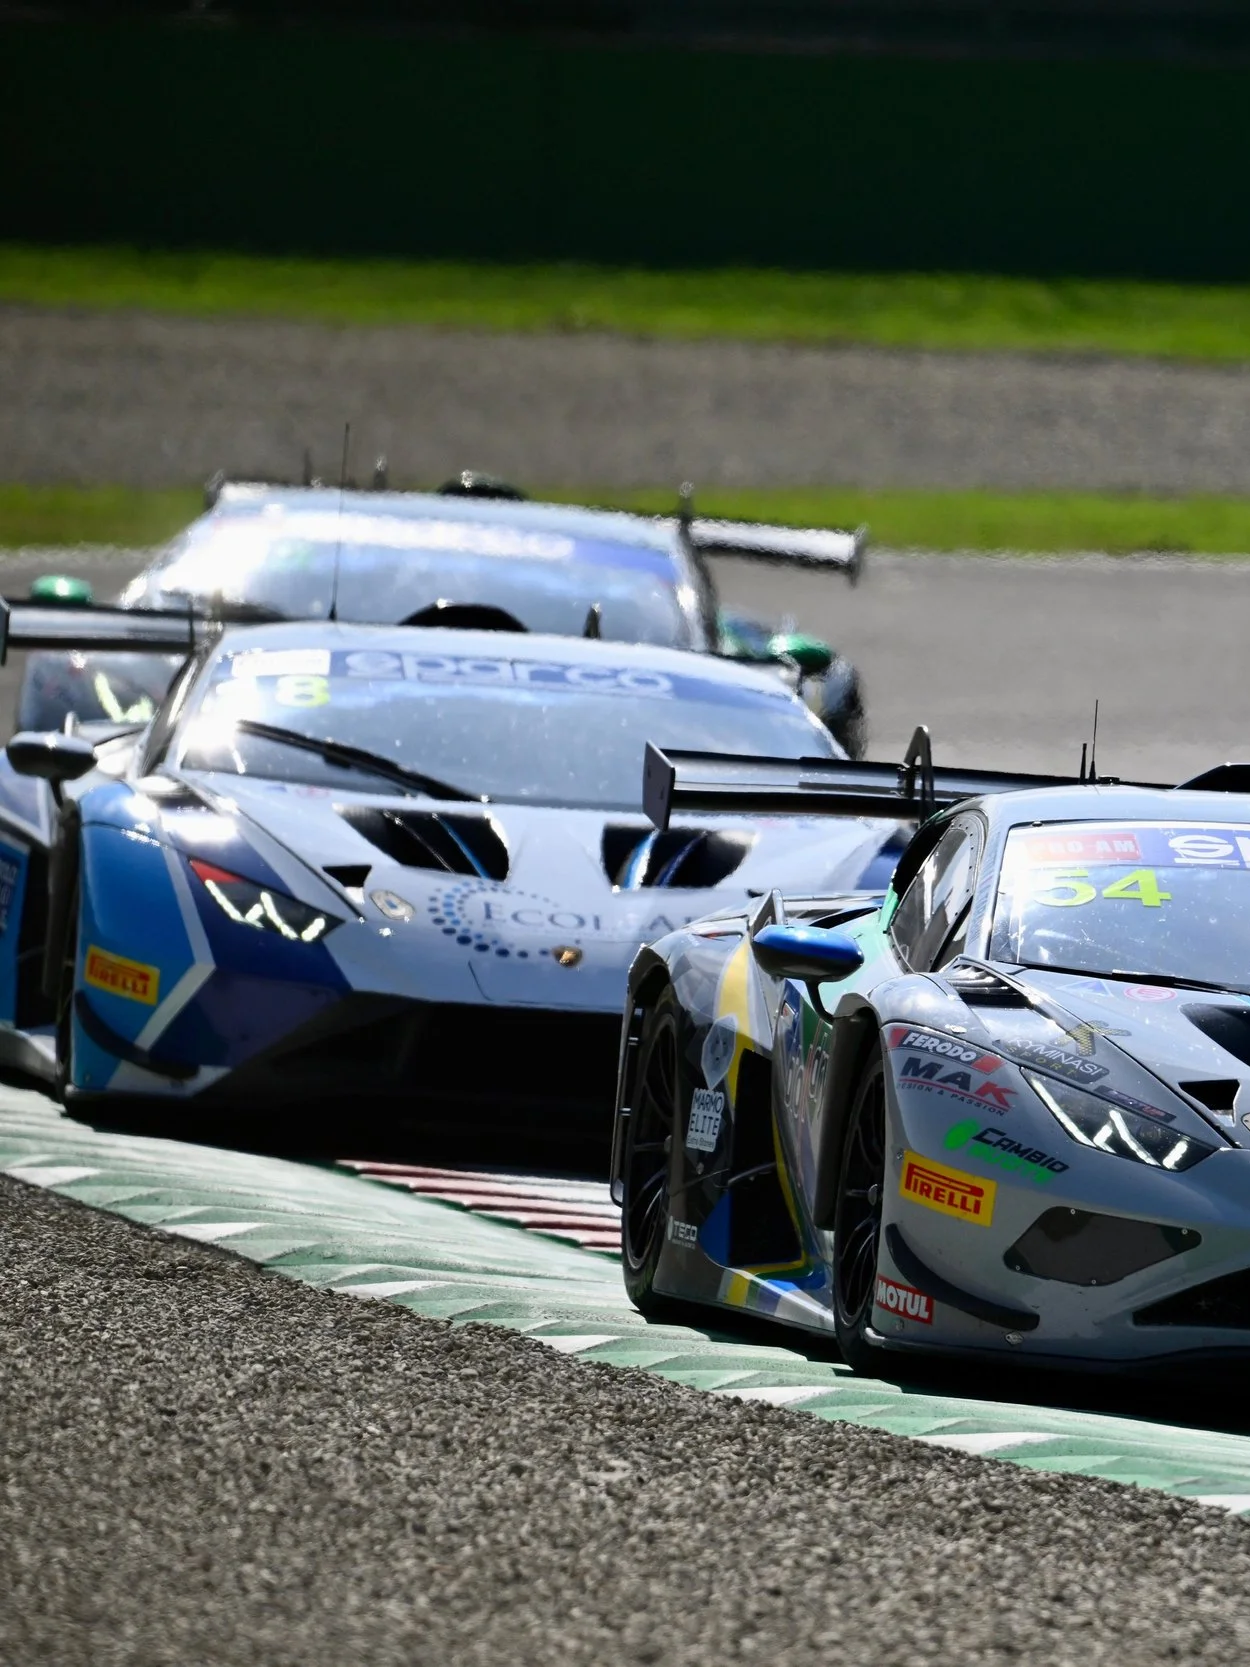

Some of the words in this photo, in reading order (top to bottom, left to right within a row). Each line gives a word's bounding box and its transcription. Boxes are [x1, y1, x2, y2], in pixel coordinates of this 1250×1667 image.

[345, 652, 673, 694] sparco
[1032, 867, 1172, 908] 54
[89, 953, 150, 996] PIRELLI
[902, 1031, 977, 1062] FERODO
[900, 1056, 1018, 1107] MAK
[693, 1092, 723, 1113] MARMO
[950, 1093, 1005, 1117] PASSION
[689, 1113, 720, 1136] ELITE
[905, 1162, 985, 1215] PIRELLI
[877, 1279, 930, 1320] MOTUL
